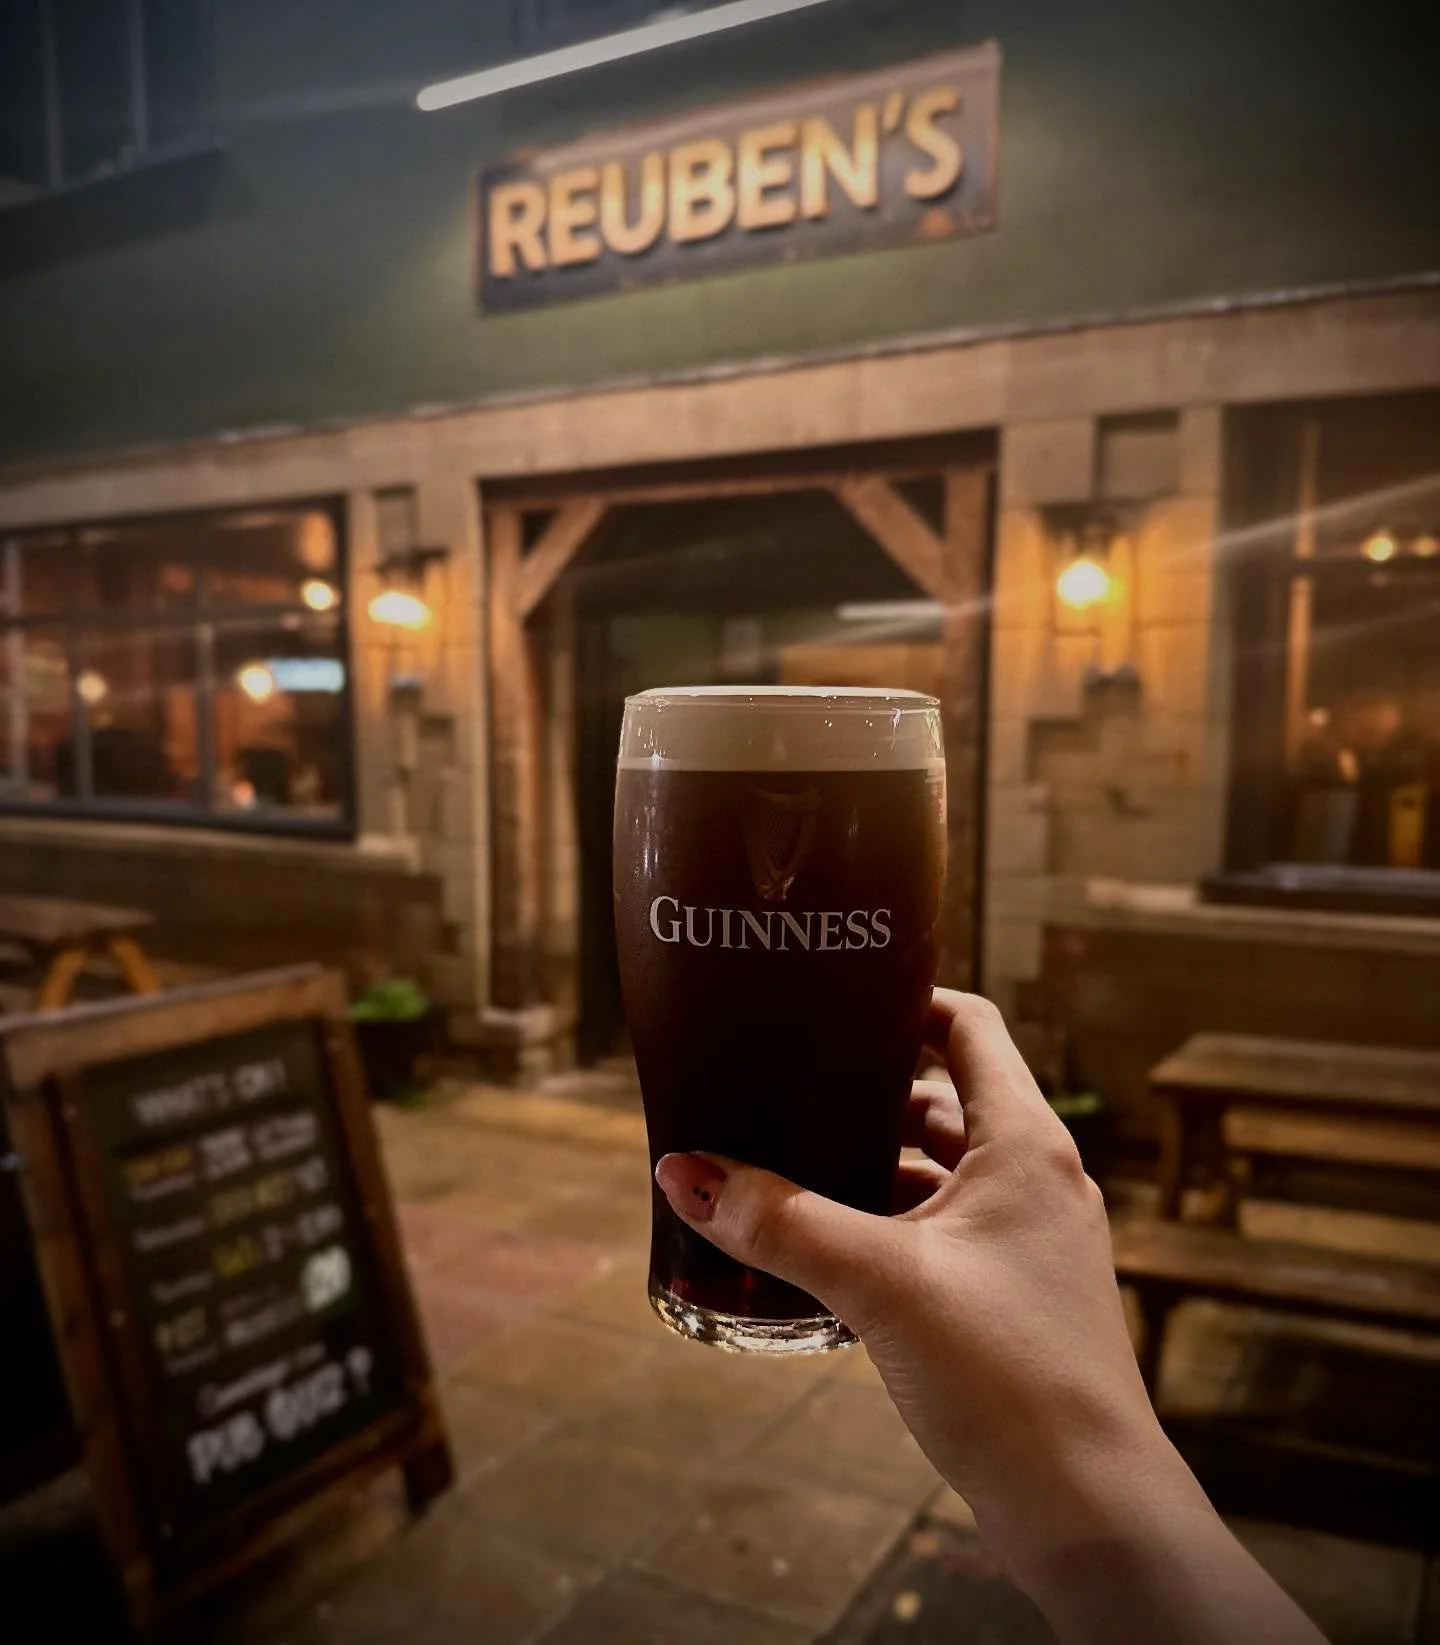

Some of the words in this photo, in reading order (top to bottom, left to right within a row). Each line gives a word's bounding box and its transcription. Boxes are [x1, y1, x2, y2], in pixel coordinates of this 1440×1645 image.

[488, 86, 963, 277] REUBEN'S
[650, 895, 892, 951] GUINNESS
[187, 1409, 264, 1485] PUB
